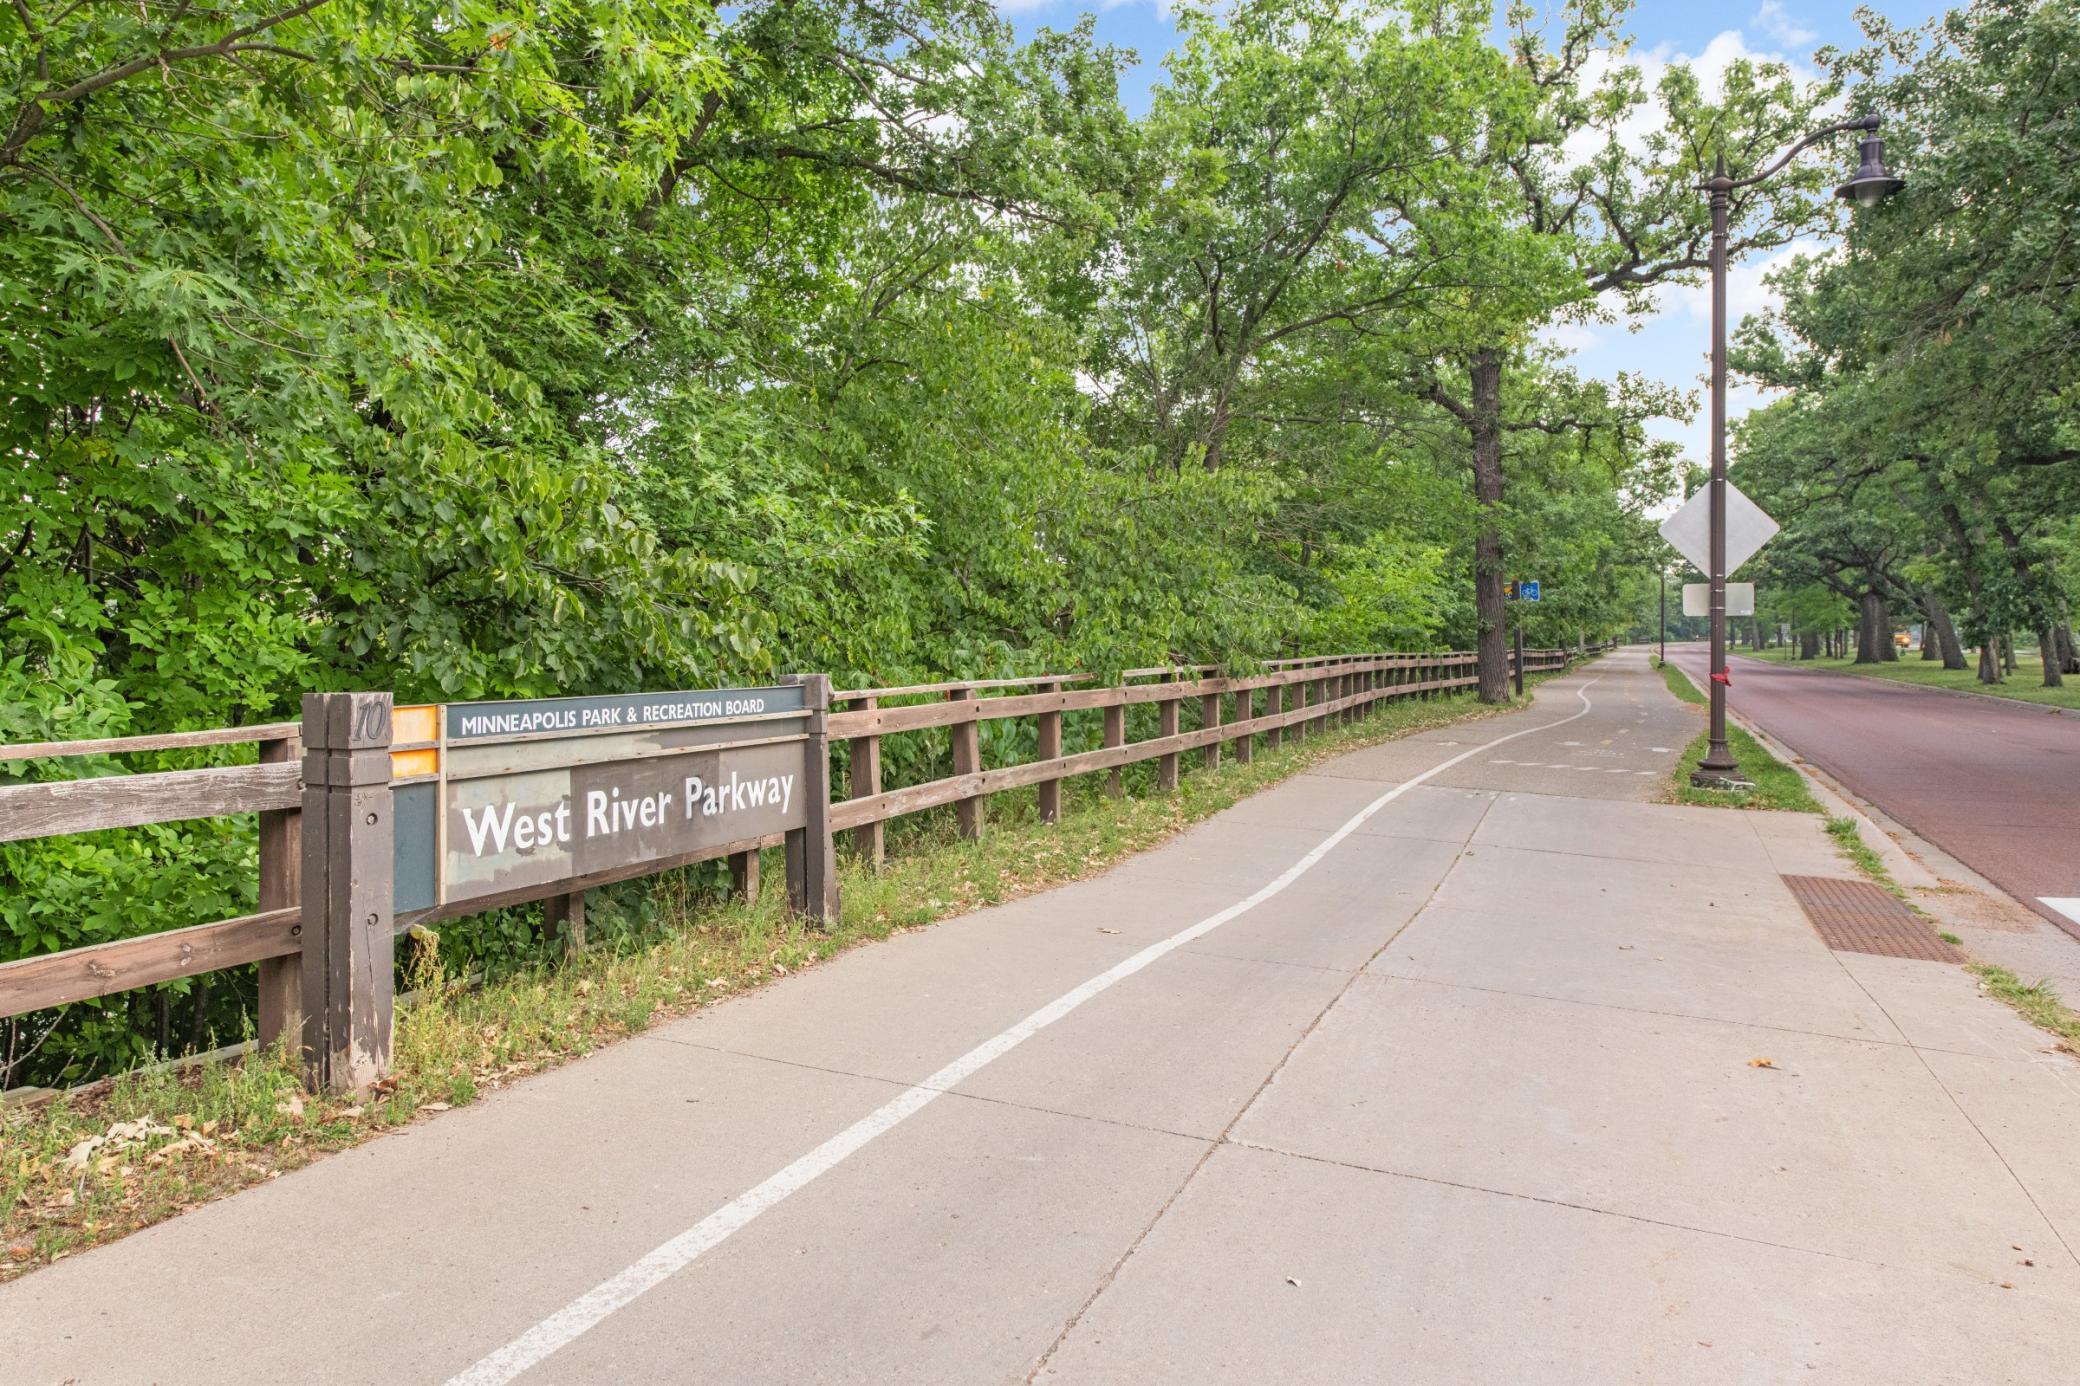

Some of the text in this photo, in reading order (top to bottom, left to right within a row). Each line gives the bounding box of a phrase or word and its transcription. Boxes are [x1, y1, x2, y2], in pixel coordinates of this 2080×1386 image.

[352, 701, 387, 741] 10
[461, 699, 765, 735] MINNEAPOLIS PARK & RECREATION BOARD
[462, 771, 794, 857] West River Parkway
